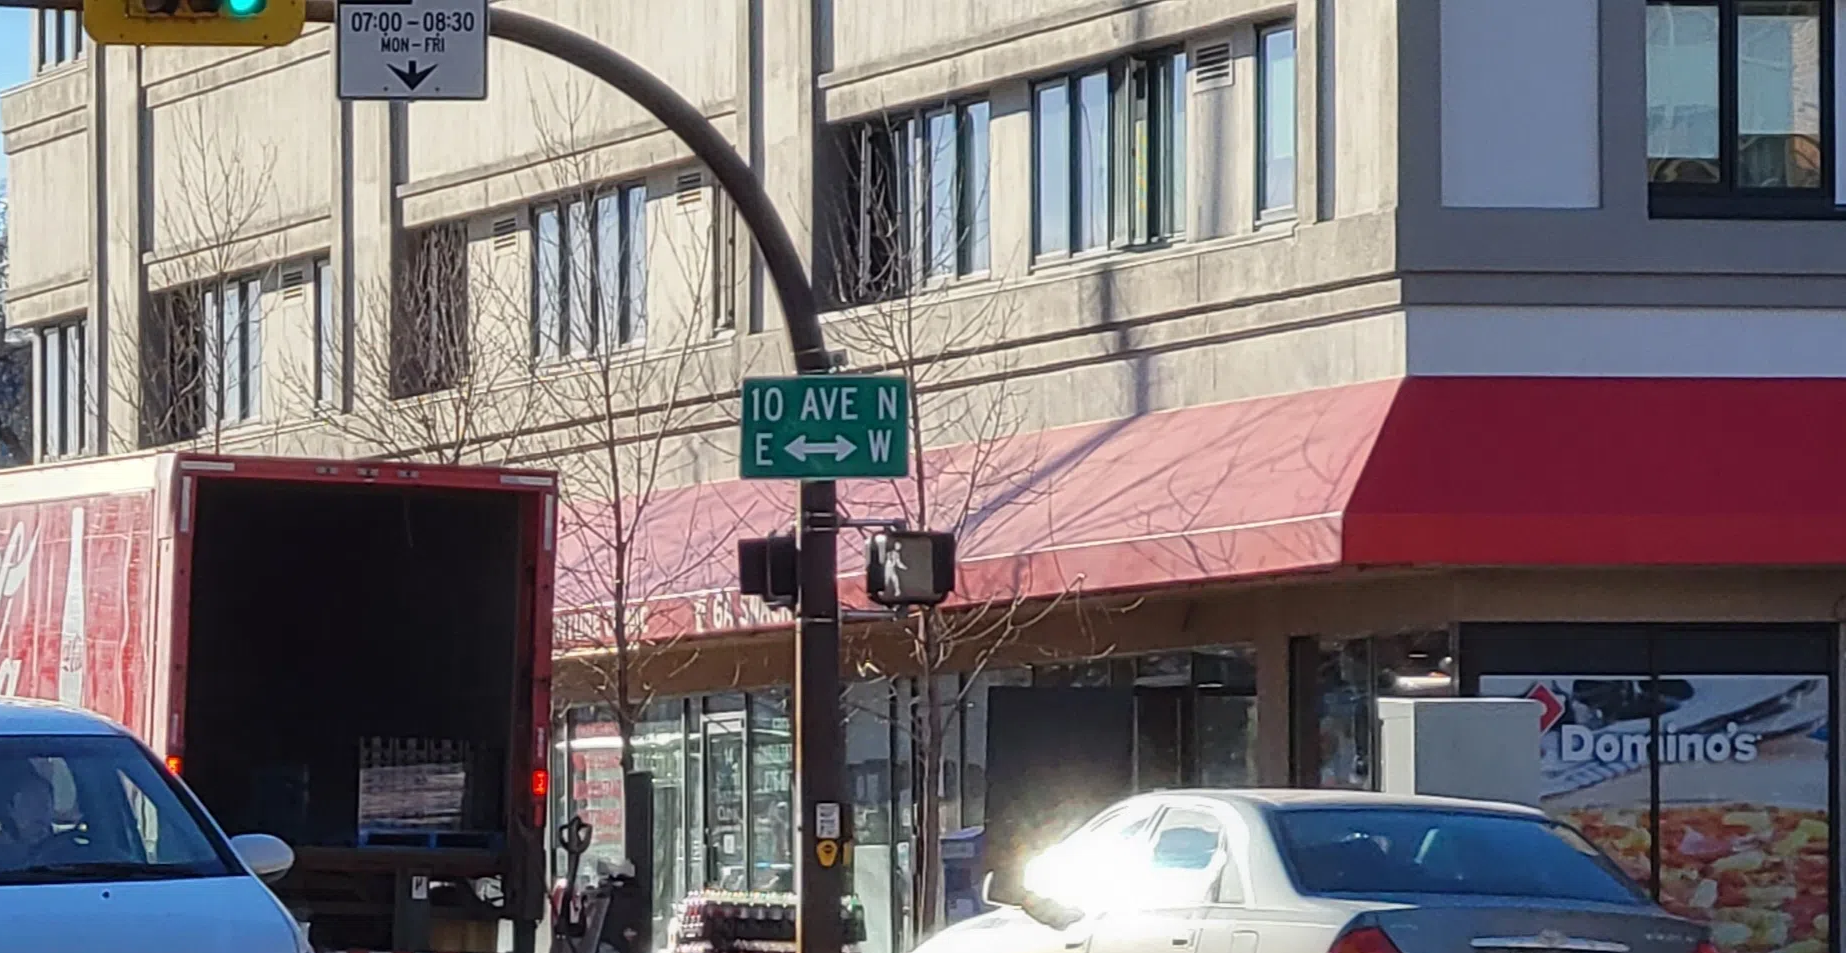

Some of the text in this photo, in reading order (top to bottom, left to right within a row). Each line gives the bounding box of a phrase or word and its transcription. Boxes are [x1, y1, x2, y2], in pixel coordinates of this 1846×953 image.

[351, 12, 402, 32] 07:00
[423, 12, 474, 32] 08:30
[751, 386, 897, 421] 10 AVE N
[756, 429, 892, 466] E W
[1561, 721, 1758, 762] Domino's
